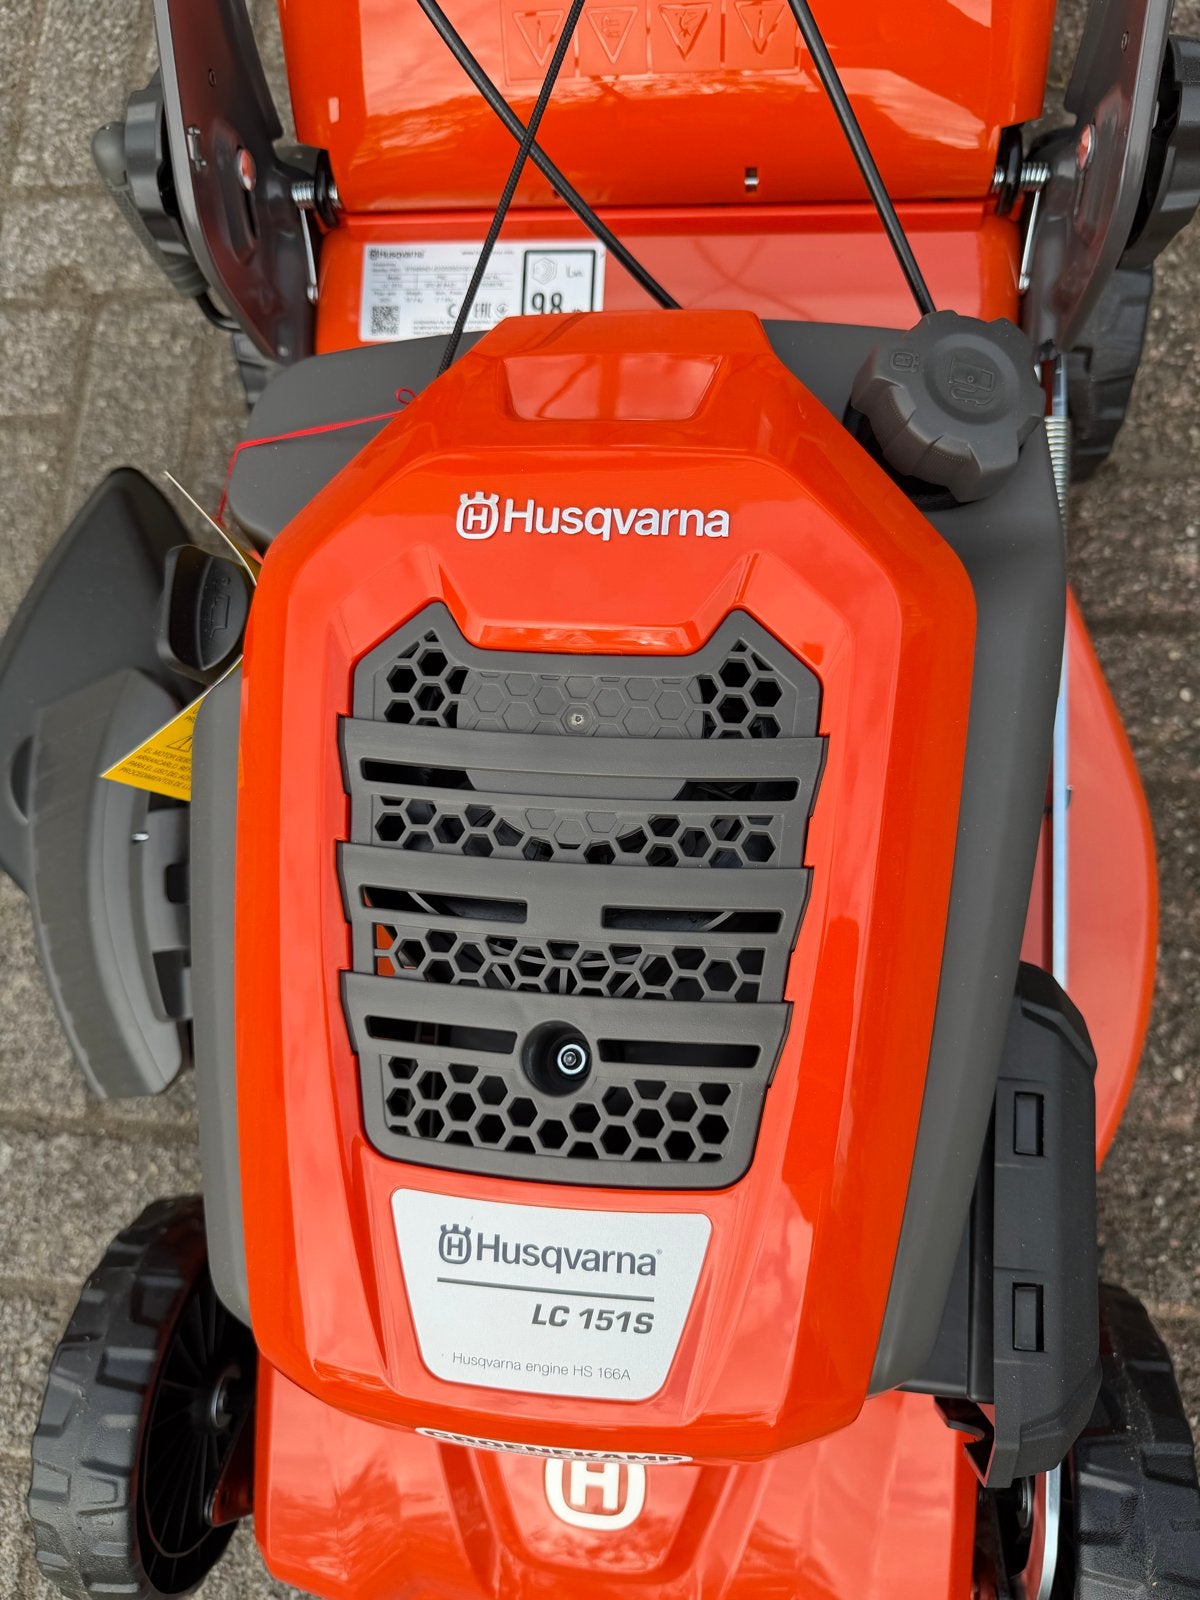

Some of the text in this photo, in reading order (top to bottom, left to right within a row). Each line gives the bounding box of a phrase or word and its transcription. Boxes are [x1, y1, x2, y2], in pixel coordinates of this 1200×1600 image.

[532, 292, 563, 315] 98
[503, 498, 731, 541] Husqvarna
[477, 1232, 656, 1275] Husqvarna
[532, 1304, 655, 1334] LC 151S
[452, 1352, 631, 1381] Husqvarna engine HS 166A
[424, 1430, 683, 1463] GROENEKAMP
